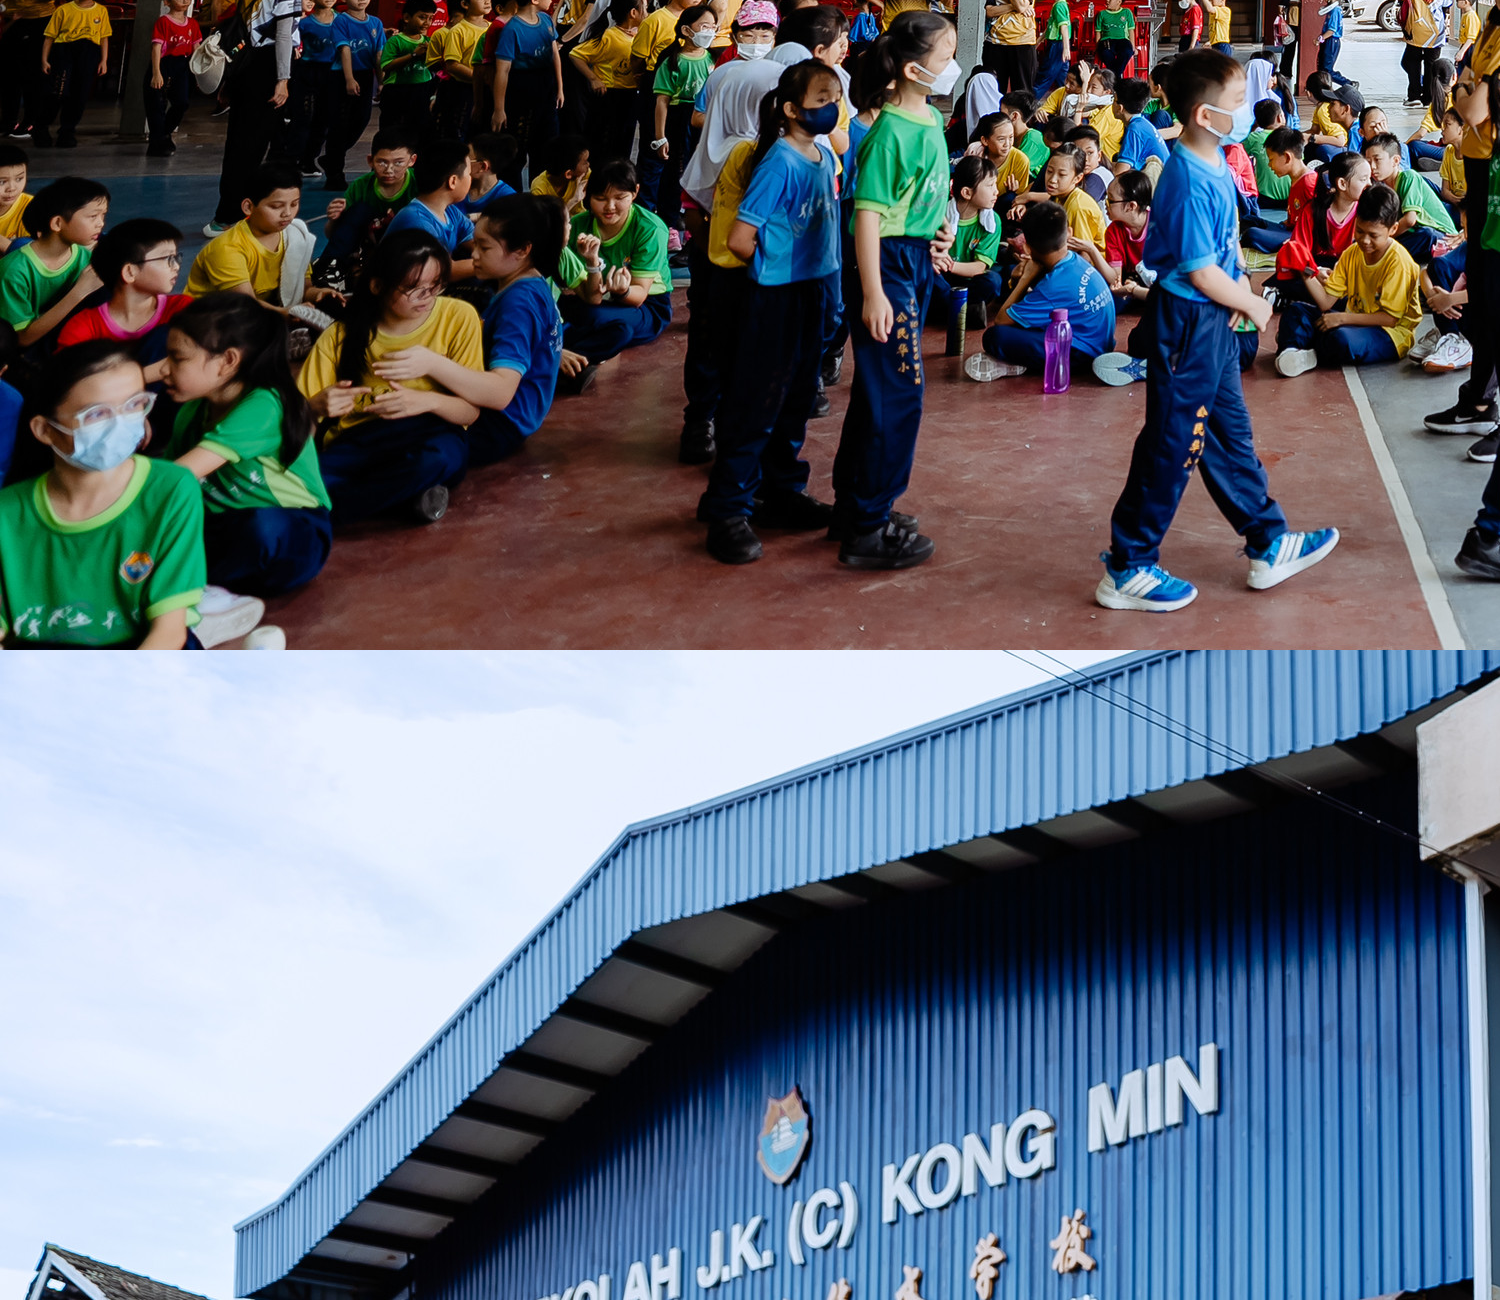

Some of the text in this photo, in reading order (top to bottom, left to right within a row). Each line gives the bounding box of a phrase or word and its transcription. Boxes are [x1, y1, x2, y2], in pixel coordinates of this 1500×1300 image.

[696, 1214, 774, 1290] J.K.
[787, 1180, 858, 1267] (C)
[882, 1107, 1057, 1225] KONG
[1087, 1042, 1219, 1155] MIN
